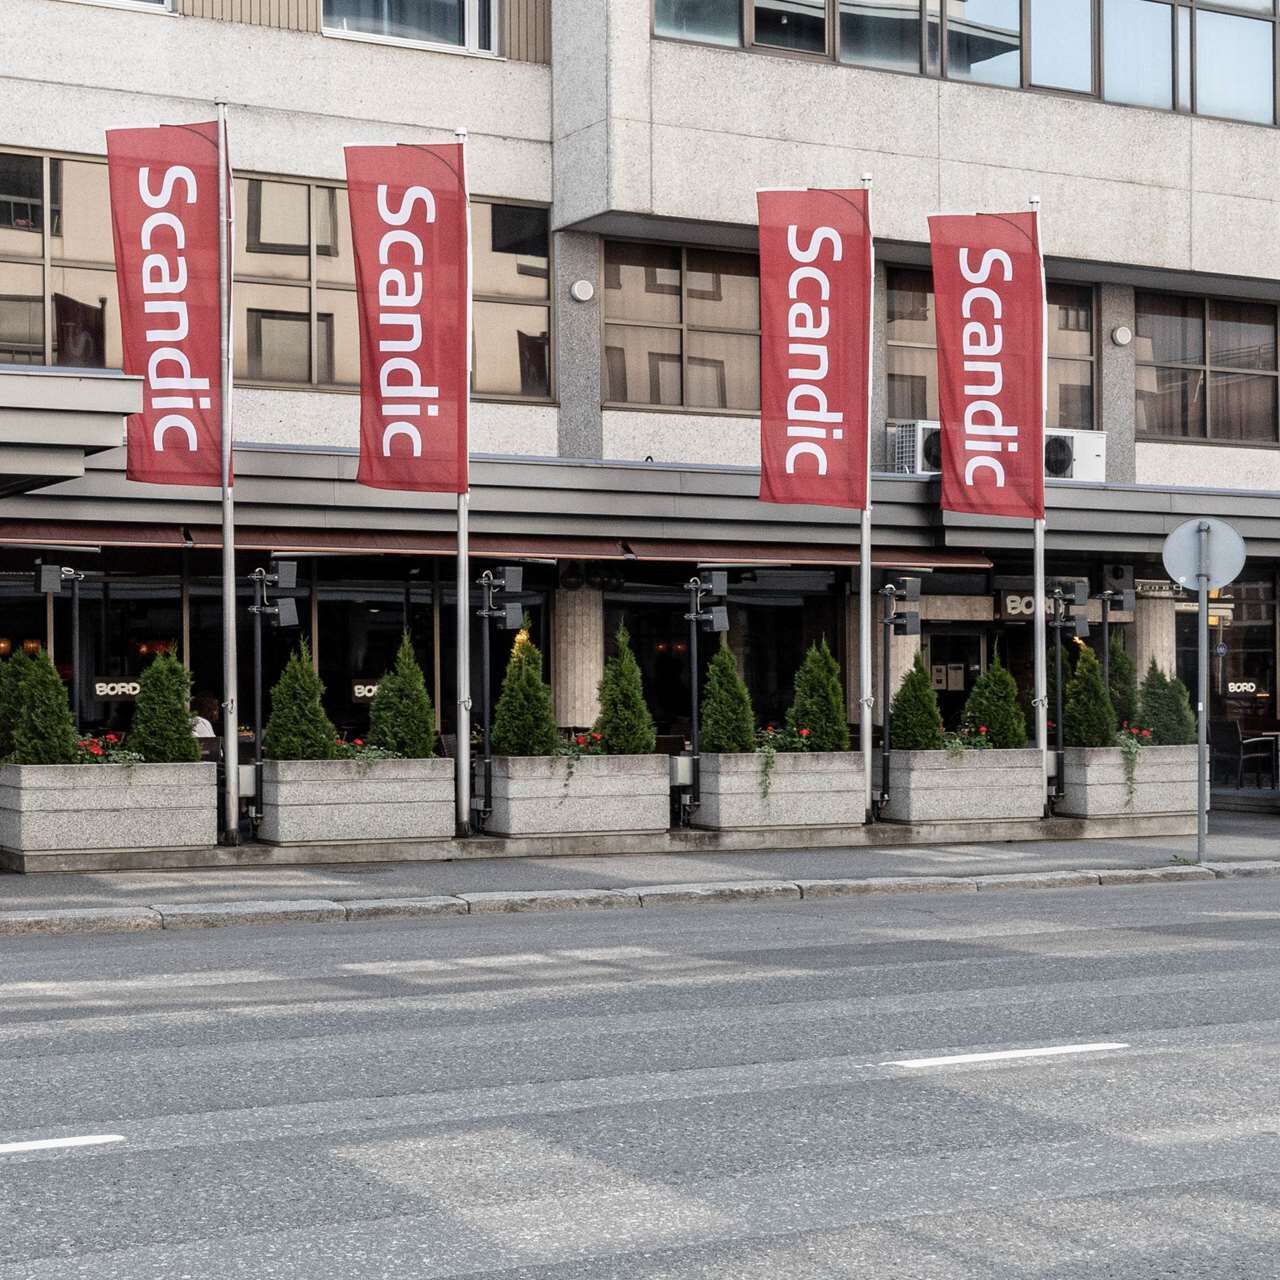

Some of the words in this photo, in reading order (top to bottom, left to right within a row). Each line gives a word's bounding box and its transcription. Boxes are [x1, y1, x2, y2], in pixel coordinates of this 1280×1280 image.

[137, 164, 212, 452] Scandic
[376, 184, 440, 457] Scandic
[784, 224, 844, 476] Scandic
[958, 247, 1019, 488] Scandic
[95, 682, 141, 696] BORD
[1228, 682, 1256, 693] BORD
